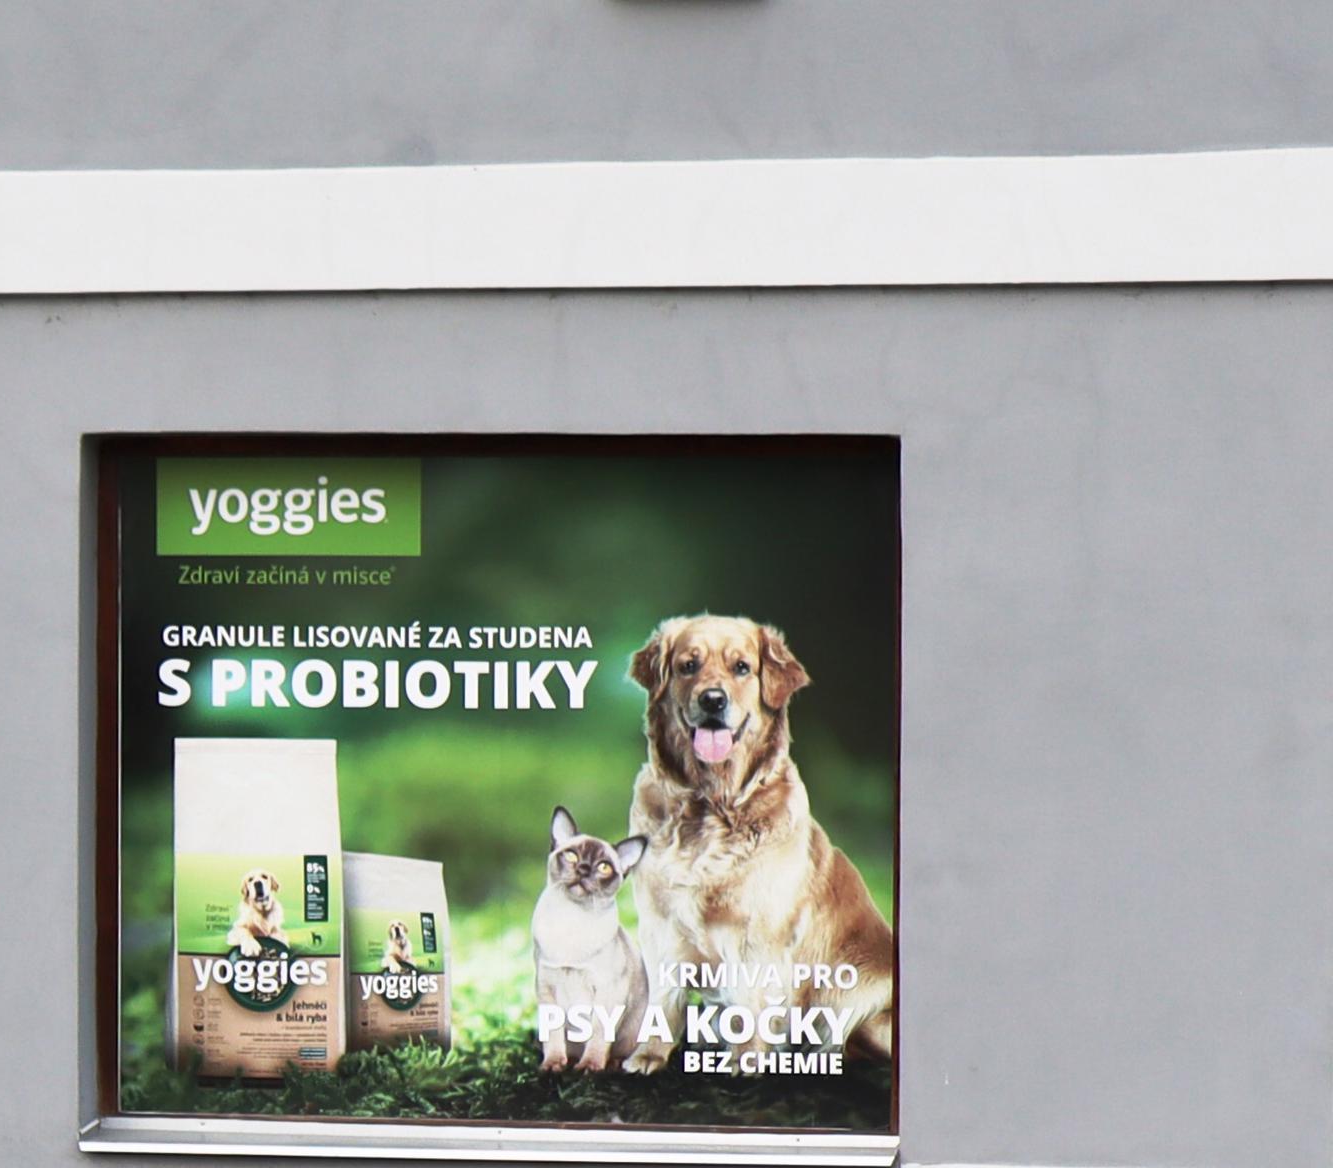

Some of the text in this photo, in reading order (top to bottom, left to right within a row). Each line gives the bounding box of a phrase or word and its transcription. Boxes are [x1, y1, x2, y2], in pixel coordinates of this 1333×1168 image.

[189, 475, 387, 536] yoggies
[178, 564, 240, 586] Zdraví
[246, 564, 310, 586] začíná
[315, 569, 327, 585] v
[162, 620, 593, 649] GRANULE LISOVANÉ ZA STUDENA
[157, 658, 599, 710] S PROBIOTIKY
[192, 952, 328, 993] yoggies
[359, 969, 439, 1000] yoggies
[658, 962, 859, 990] KRMIVA PRO
[538, 994, 856, 1046] PSY A KOČKY
[683, 1050, 844, 1076] BEZ CHEMIE
